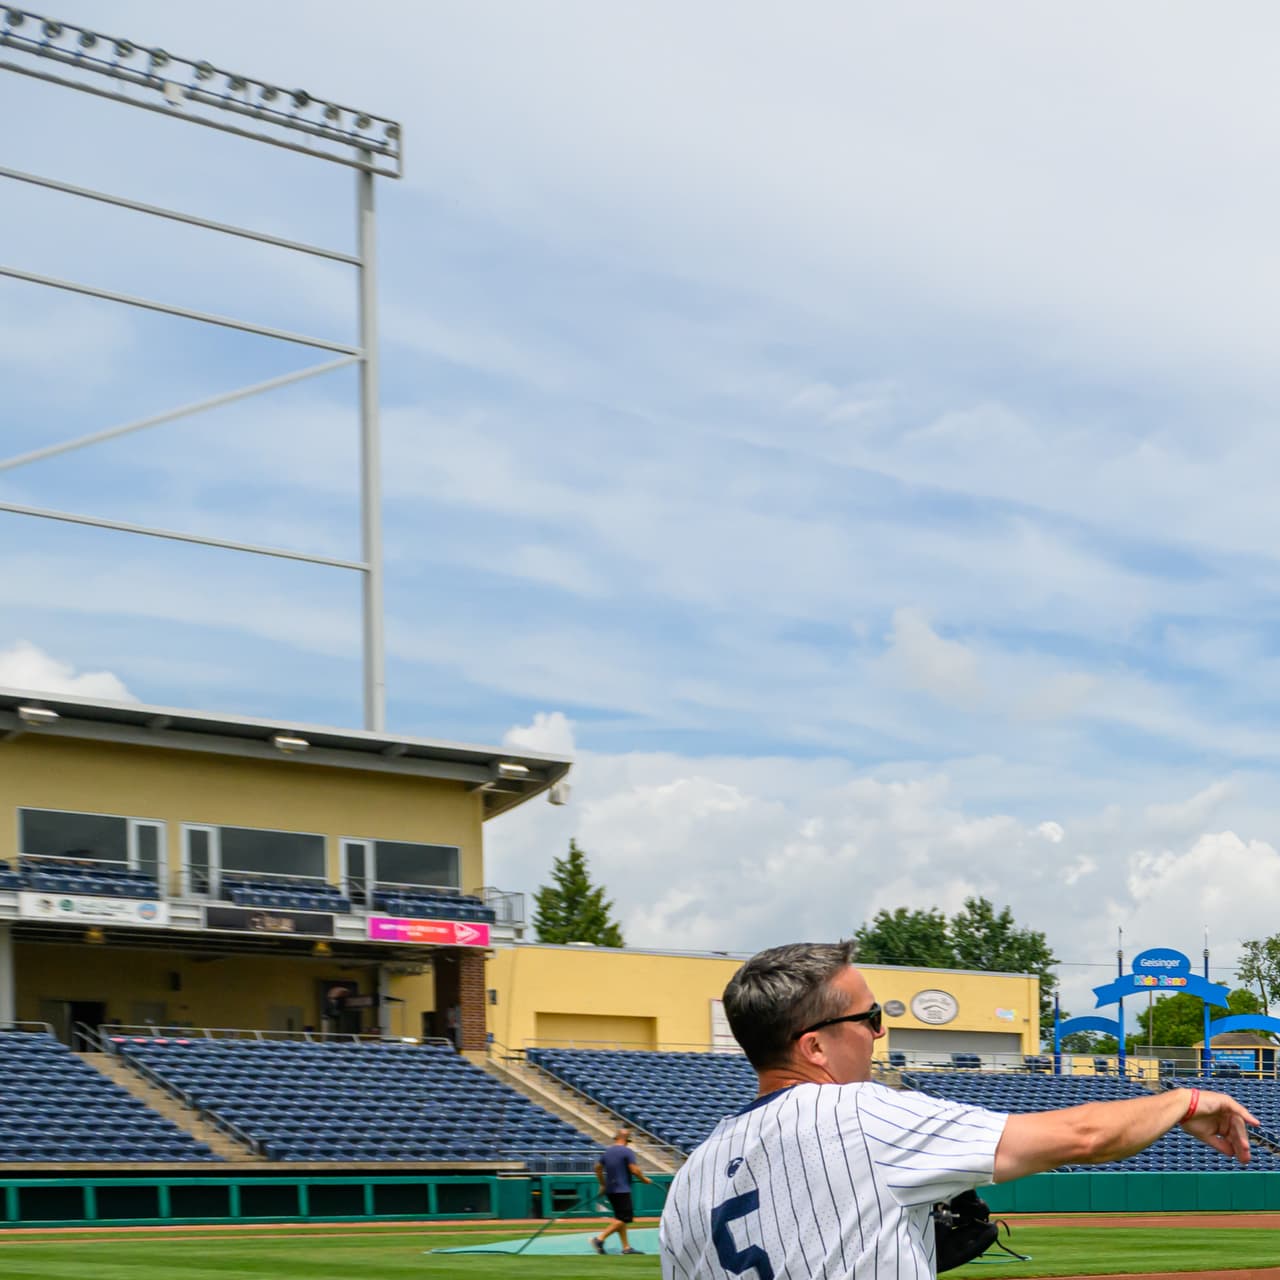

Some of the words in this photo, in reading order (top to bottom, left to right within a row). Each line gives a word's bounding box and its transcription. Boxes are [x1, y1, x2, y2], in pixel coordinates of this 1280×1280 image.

[1140, 958, 1181, 969] Geisinger
[1133, 974, 1158, 986] Kids
[1159, 975, 1188, 986] Zone
